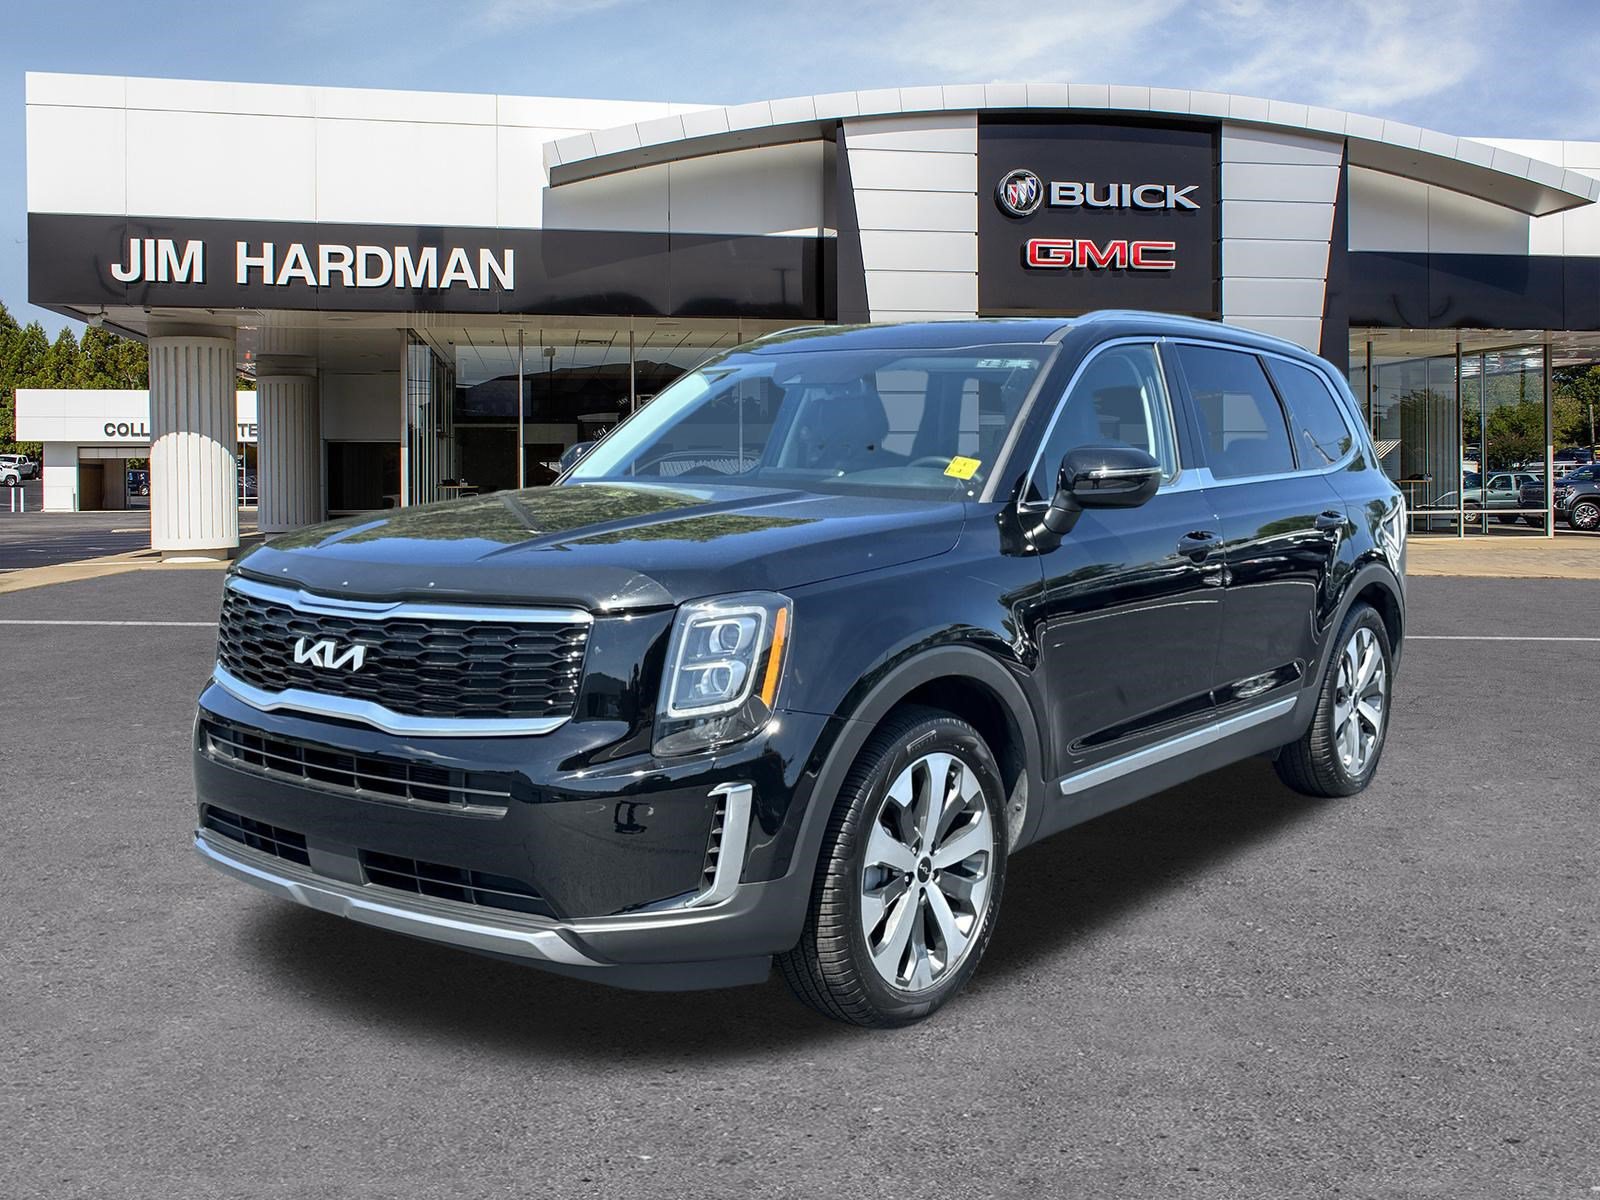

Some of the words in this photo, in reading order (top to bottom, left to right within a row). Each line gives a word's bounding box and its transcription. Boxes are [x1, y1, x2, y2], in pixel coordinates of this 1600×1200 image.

[1050, 181, 1200, 209] BUICK
[110, 237, 204, 283] JIM
[236, 240, 515, 291] HARDMAN
[1026, 238, 1176, 270] GMC
[294, 636, 366, 672] KIA
